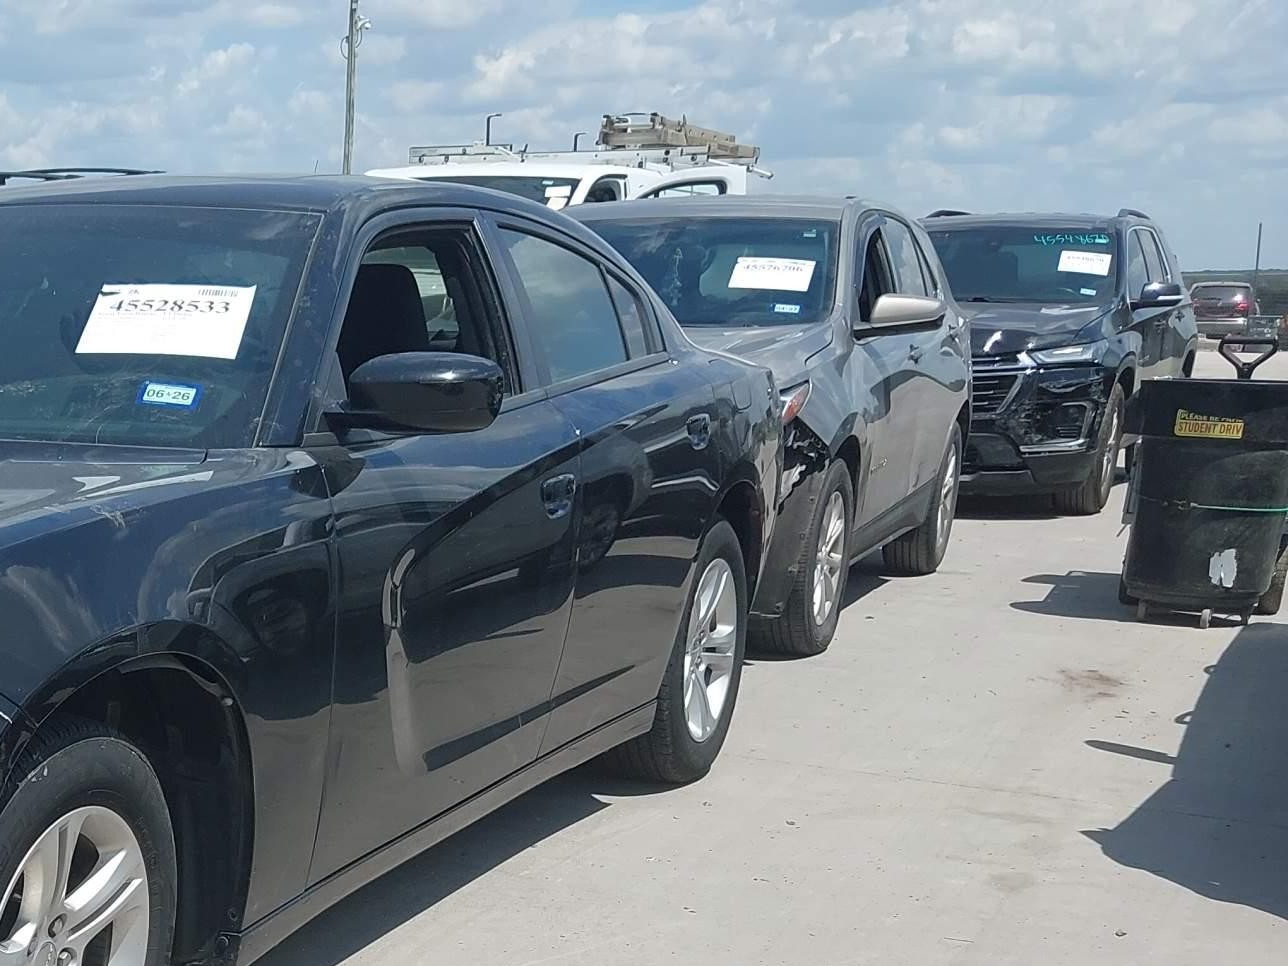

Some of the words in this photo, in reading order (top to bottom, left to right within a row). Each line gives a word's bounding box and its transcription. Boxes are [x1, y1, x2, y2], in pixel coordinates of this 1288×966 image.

[109, 299, 231, 314] 45528533
[1181, 411, 1208, 421] PLEASE
[1178, 421, 1218, 433] STUDENT
[1219, 424, 1242, 435] DRIV
